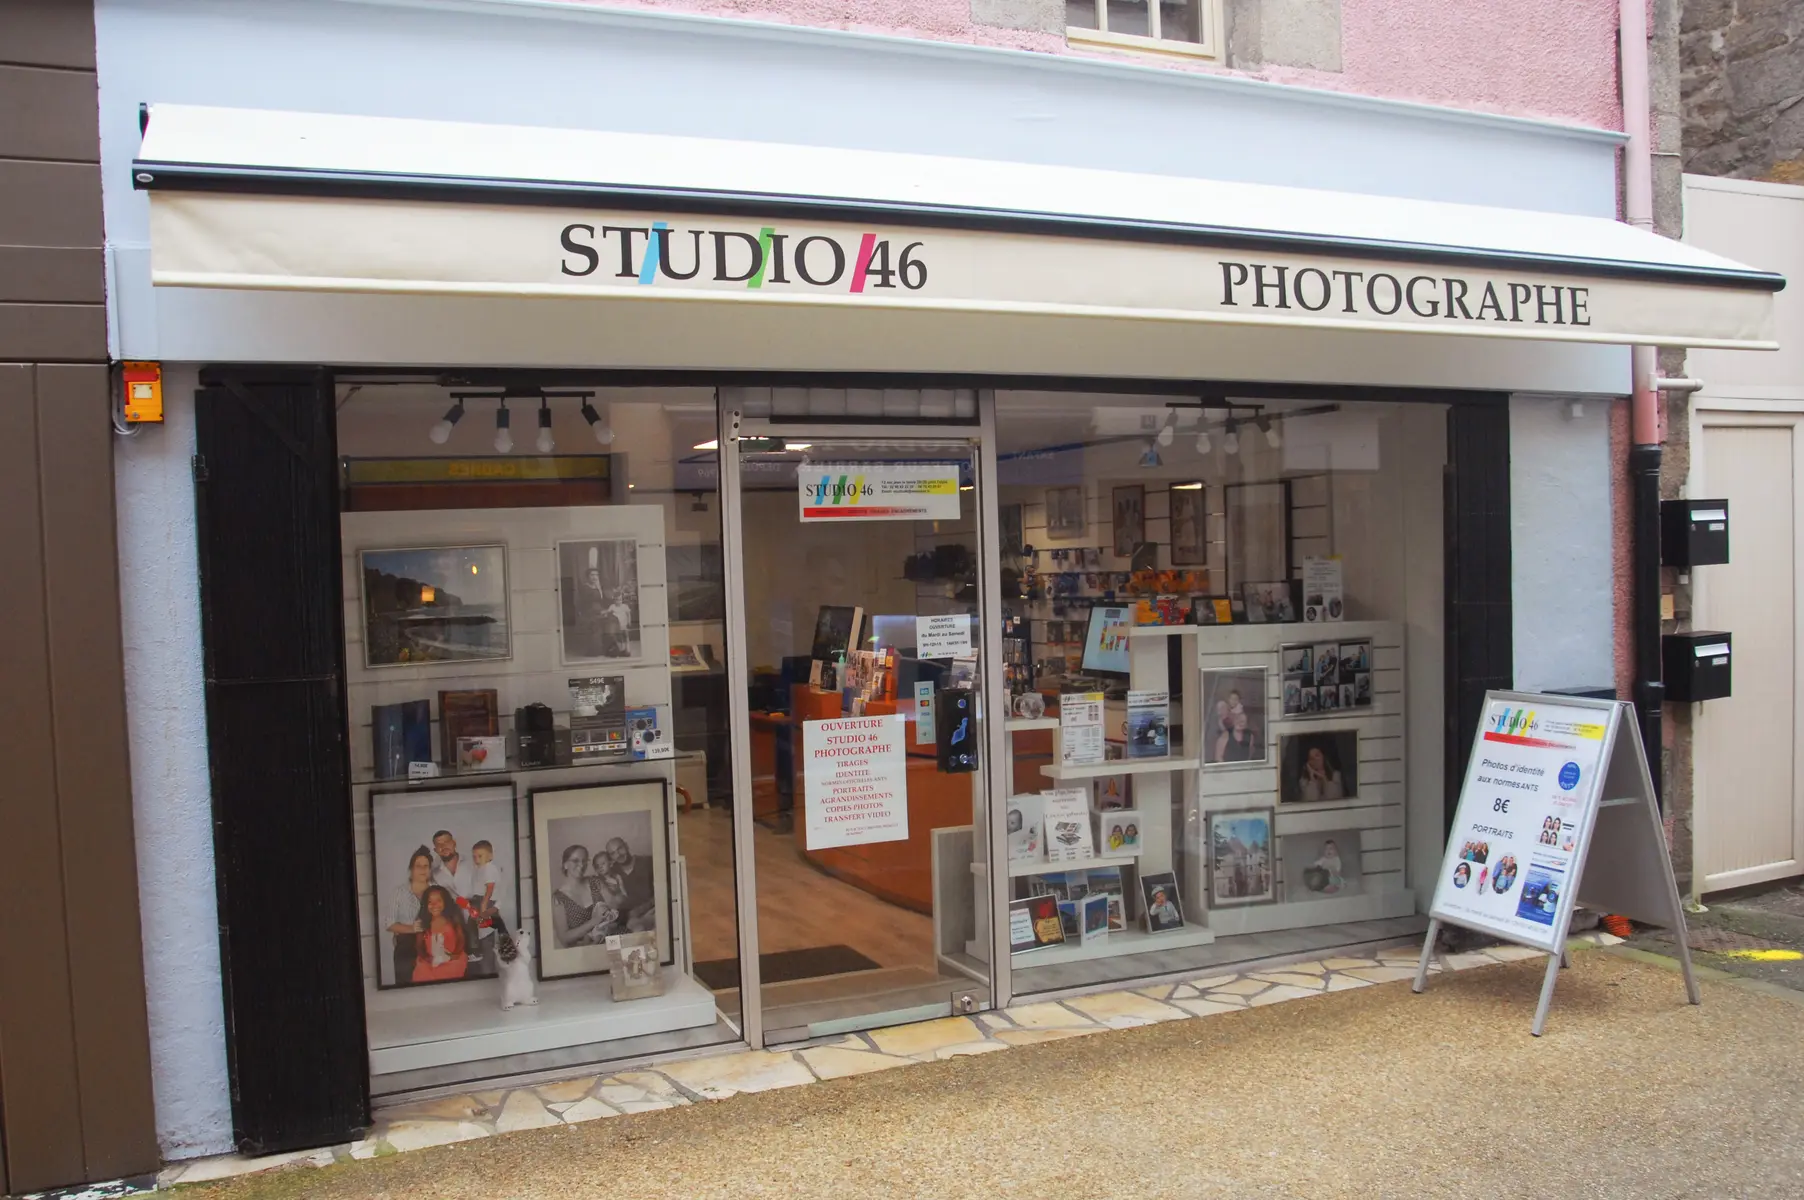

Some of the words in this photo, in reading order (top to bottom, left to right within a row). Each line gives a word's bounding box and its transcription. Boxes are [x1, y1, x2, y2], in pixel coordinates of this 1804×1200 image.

[560, 223, 846, 286] STUDIO
[865, 240, 928, 290] 46
[1218, 261, 1592, 326] PHOTOGRAPHE
[806, 483, 857, 497] STUDIO
[860, 483, 874, 497] 46
[821, 719, 883, 732] OUVERTURE
[1489, 713, 1528, 730] STUDIO
[1529, 718, 1540, 731] 46
[827, 734, 866, 745] STUDIO
[868, 733, 878, 742] 46
[814, 744, 892, 758] PHOTOGRAPHE
[836, 759, 869, 768] TIRAGES
[1481, 758, 1508, 771] Photos
[1510, 762, 1545, 777] d'identité
[835, 769, 870, 778] IDENTITE
[832, 785, 874, 794] PORTRAITS
[1477, 774, 1491, 784] aux
[1492, 777, 1520, 789] normes
[1520, 782, 1540, 792] ANTS
[820, 792, 893, 804] AGRANDISSEMENTS
[825, 805, 852, 813] COPIES
[853, 802, 884, 811] PHOTOS
[1493, 797, 1511, 814] 8€
[824, 813, 865, 823] TRANSFERT
[867, 811, 891, 819] VIDEO
[1472, 823, 1514, 839] PORTRAITS
